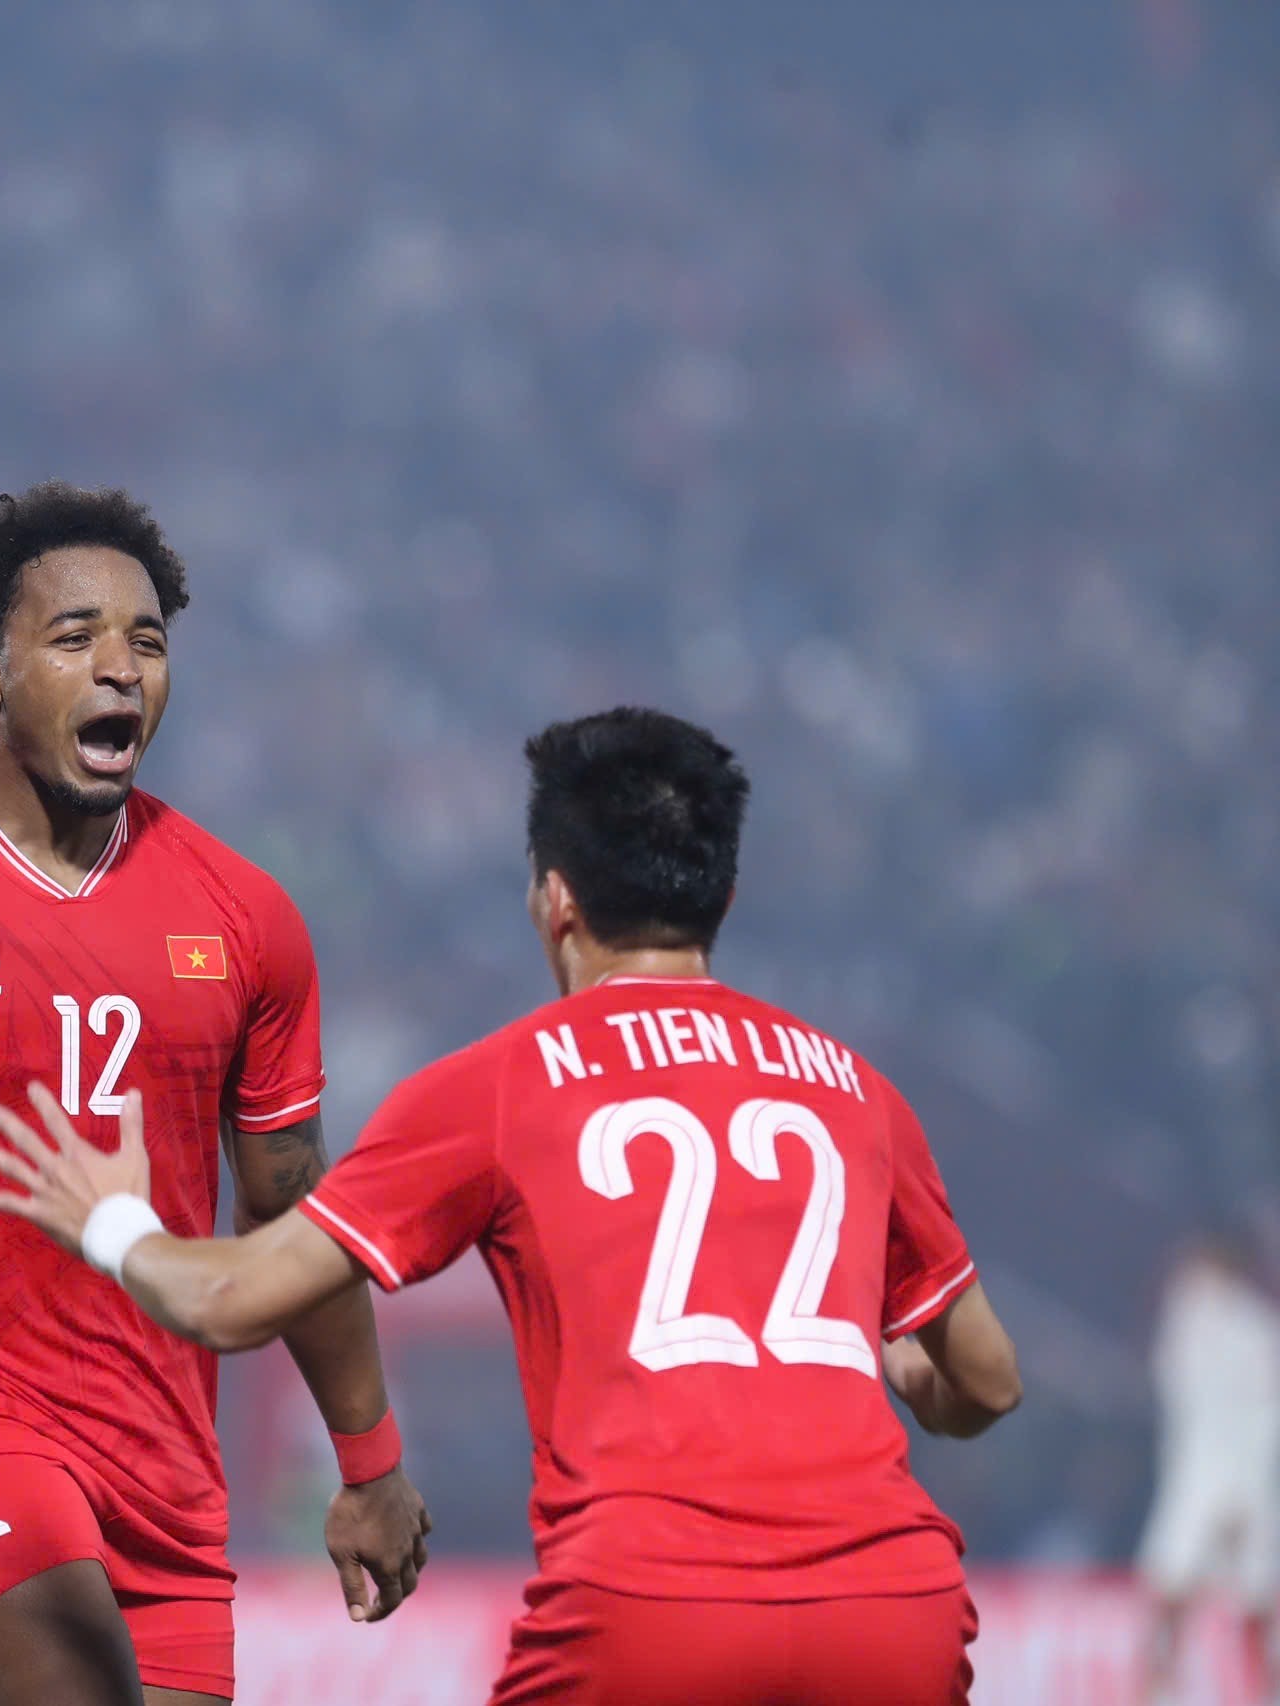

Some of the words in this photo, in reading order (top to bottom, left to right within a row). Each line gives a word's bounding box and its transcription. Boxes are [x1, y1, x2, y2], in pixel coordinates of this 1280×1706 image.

[52, 994, 142, 1116] 12
[535, 1024, 604, 1088] N.
[606, 1008, 738, 1070] TIEN
[741, 1018, 866, 1102] LINH
[577, 1096, 878, 1380] 22
